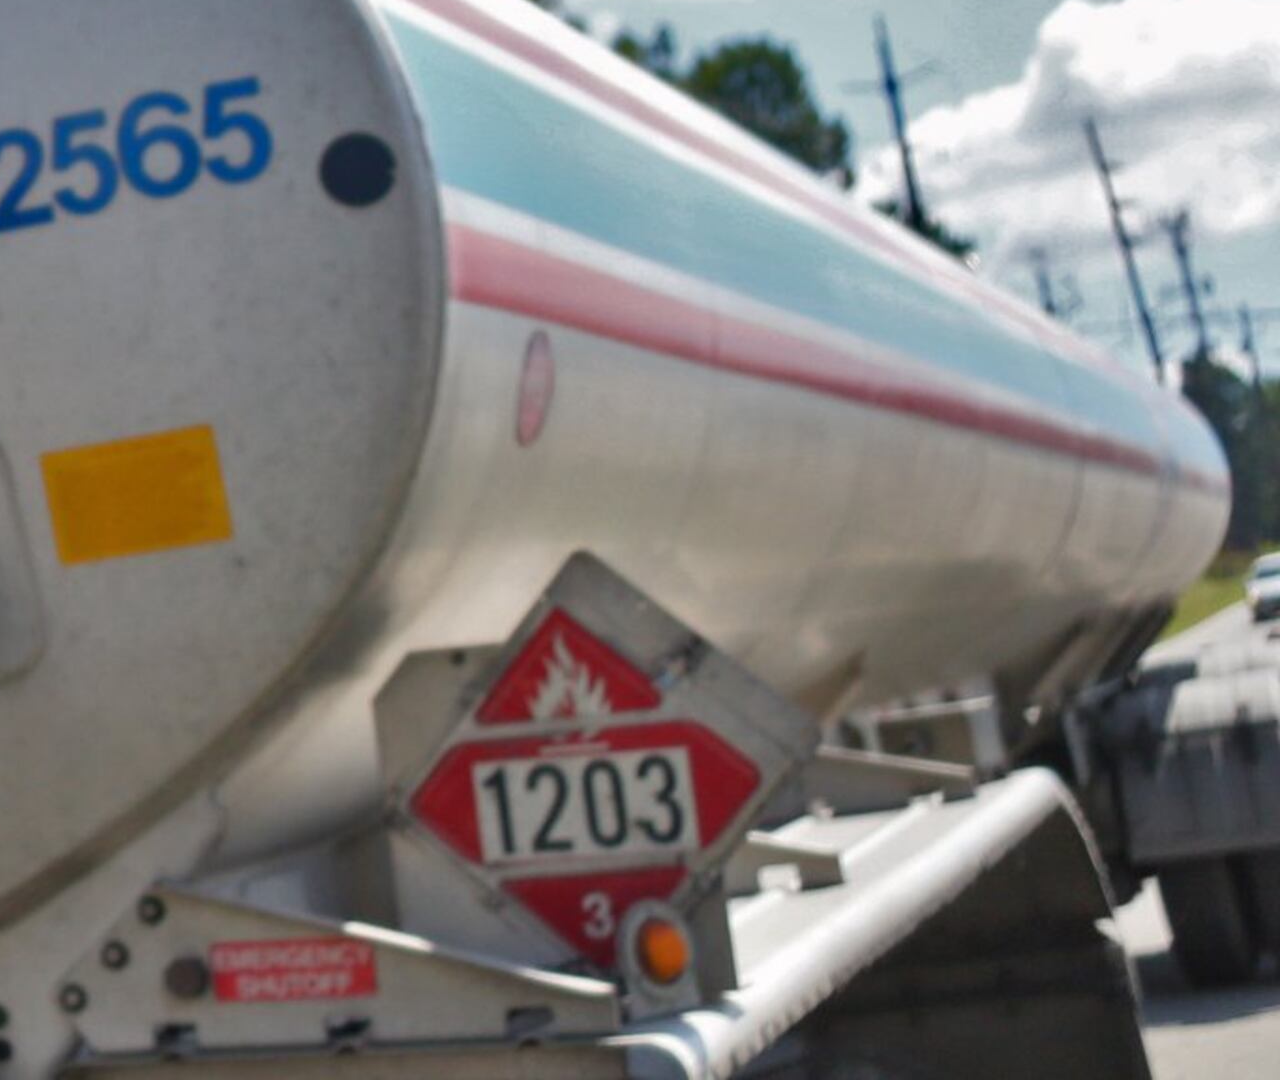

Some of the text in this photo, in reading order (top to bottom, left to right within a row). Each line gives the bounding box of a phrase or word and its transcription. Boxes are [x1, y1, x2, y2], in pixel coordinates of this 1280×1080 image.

[482, 754, 685, 856] 1203
[581, 892, 614, 940] 3
[212, 941, 372, 969] EMERGENCY
[235, 971, 351, 997] SHUTOFF
